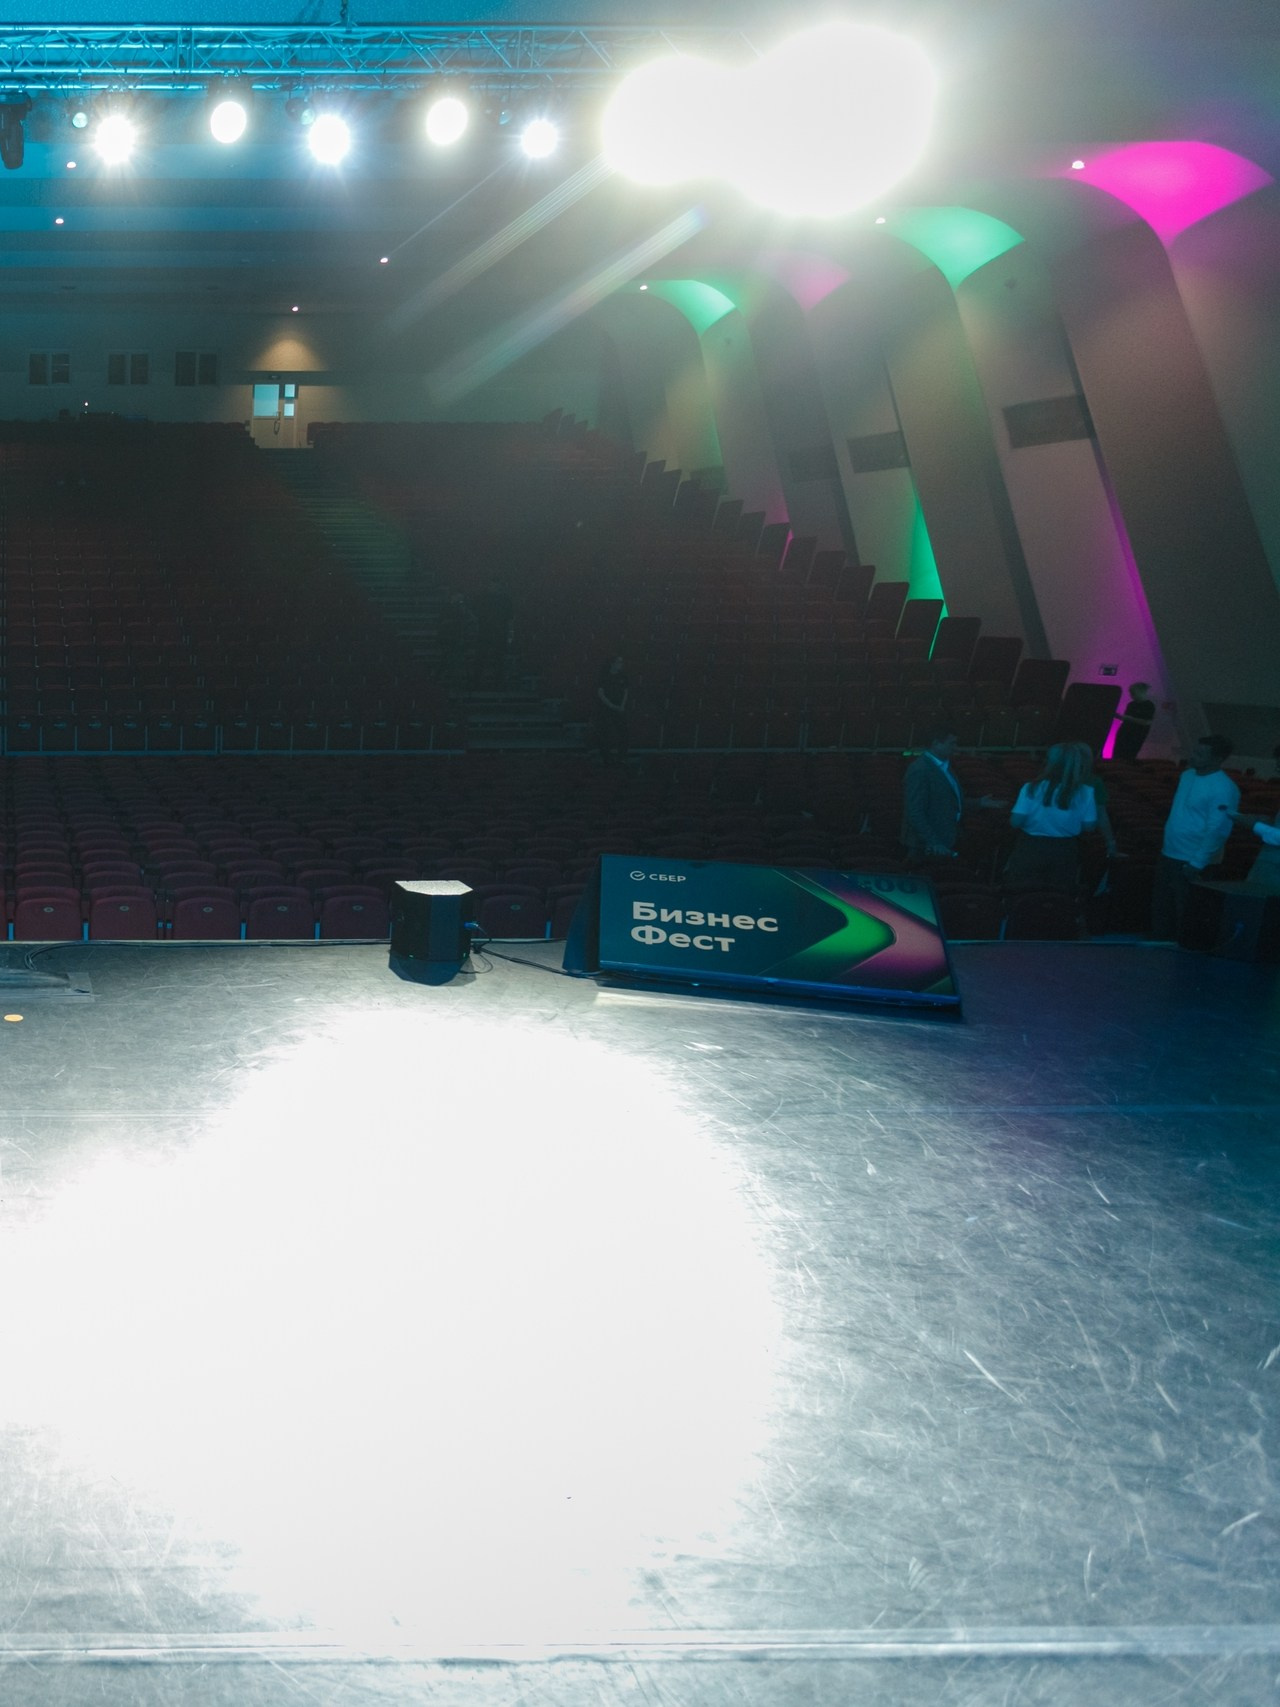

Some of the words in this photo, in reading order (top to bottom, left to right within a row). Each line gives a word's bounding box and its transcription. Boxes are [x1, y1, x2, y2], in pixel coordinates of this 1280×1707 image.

[649, 873, 687, 883] СБЕР
[632, 901, 779, 932] Бизнес
[630, 924, 736, 952] Фест
